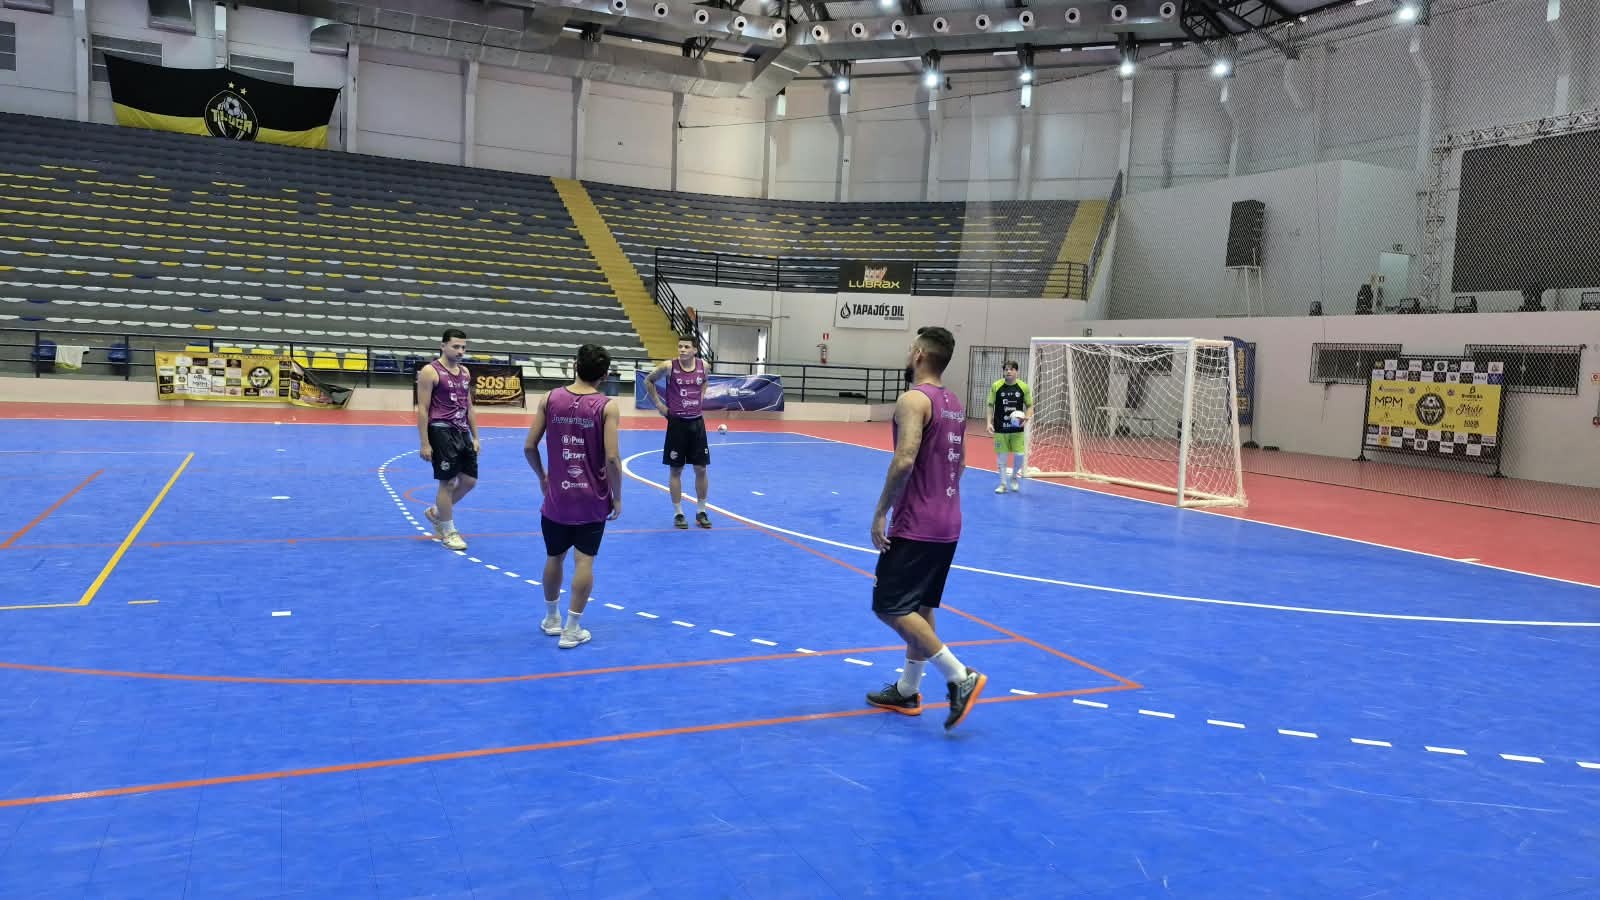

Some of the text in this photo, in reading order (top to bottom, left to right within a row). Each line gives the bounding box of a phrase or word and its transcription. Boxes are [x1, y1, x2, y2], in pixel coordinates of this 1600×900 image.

[853, 302, 905, 317] TAPAJÓS OIL
[476, 375, 505, 389] SOS
[1374, 396, 1403, 408] MPM
